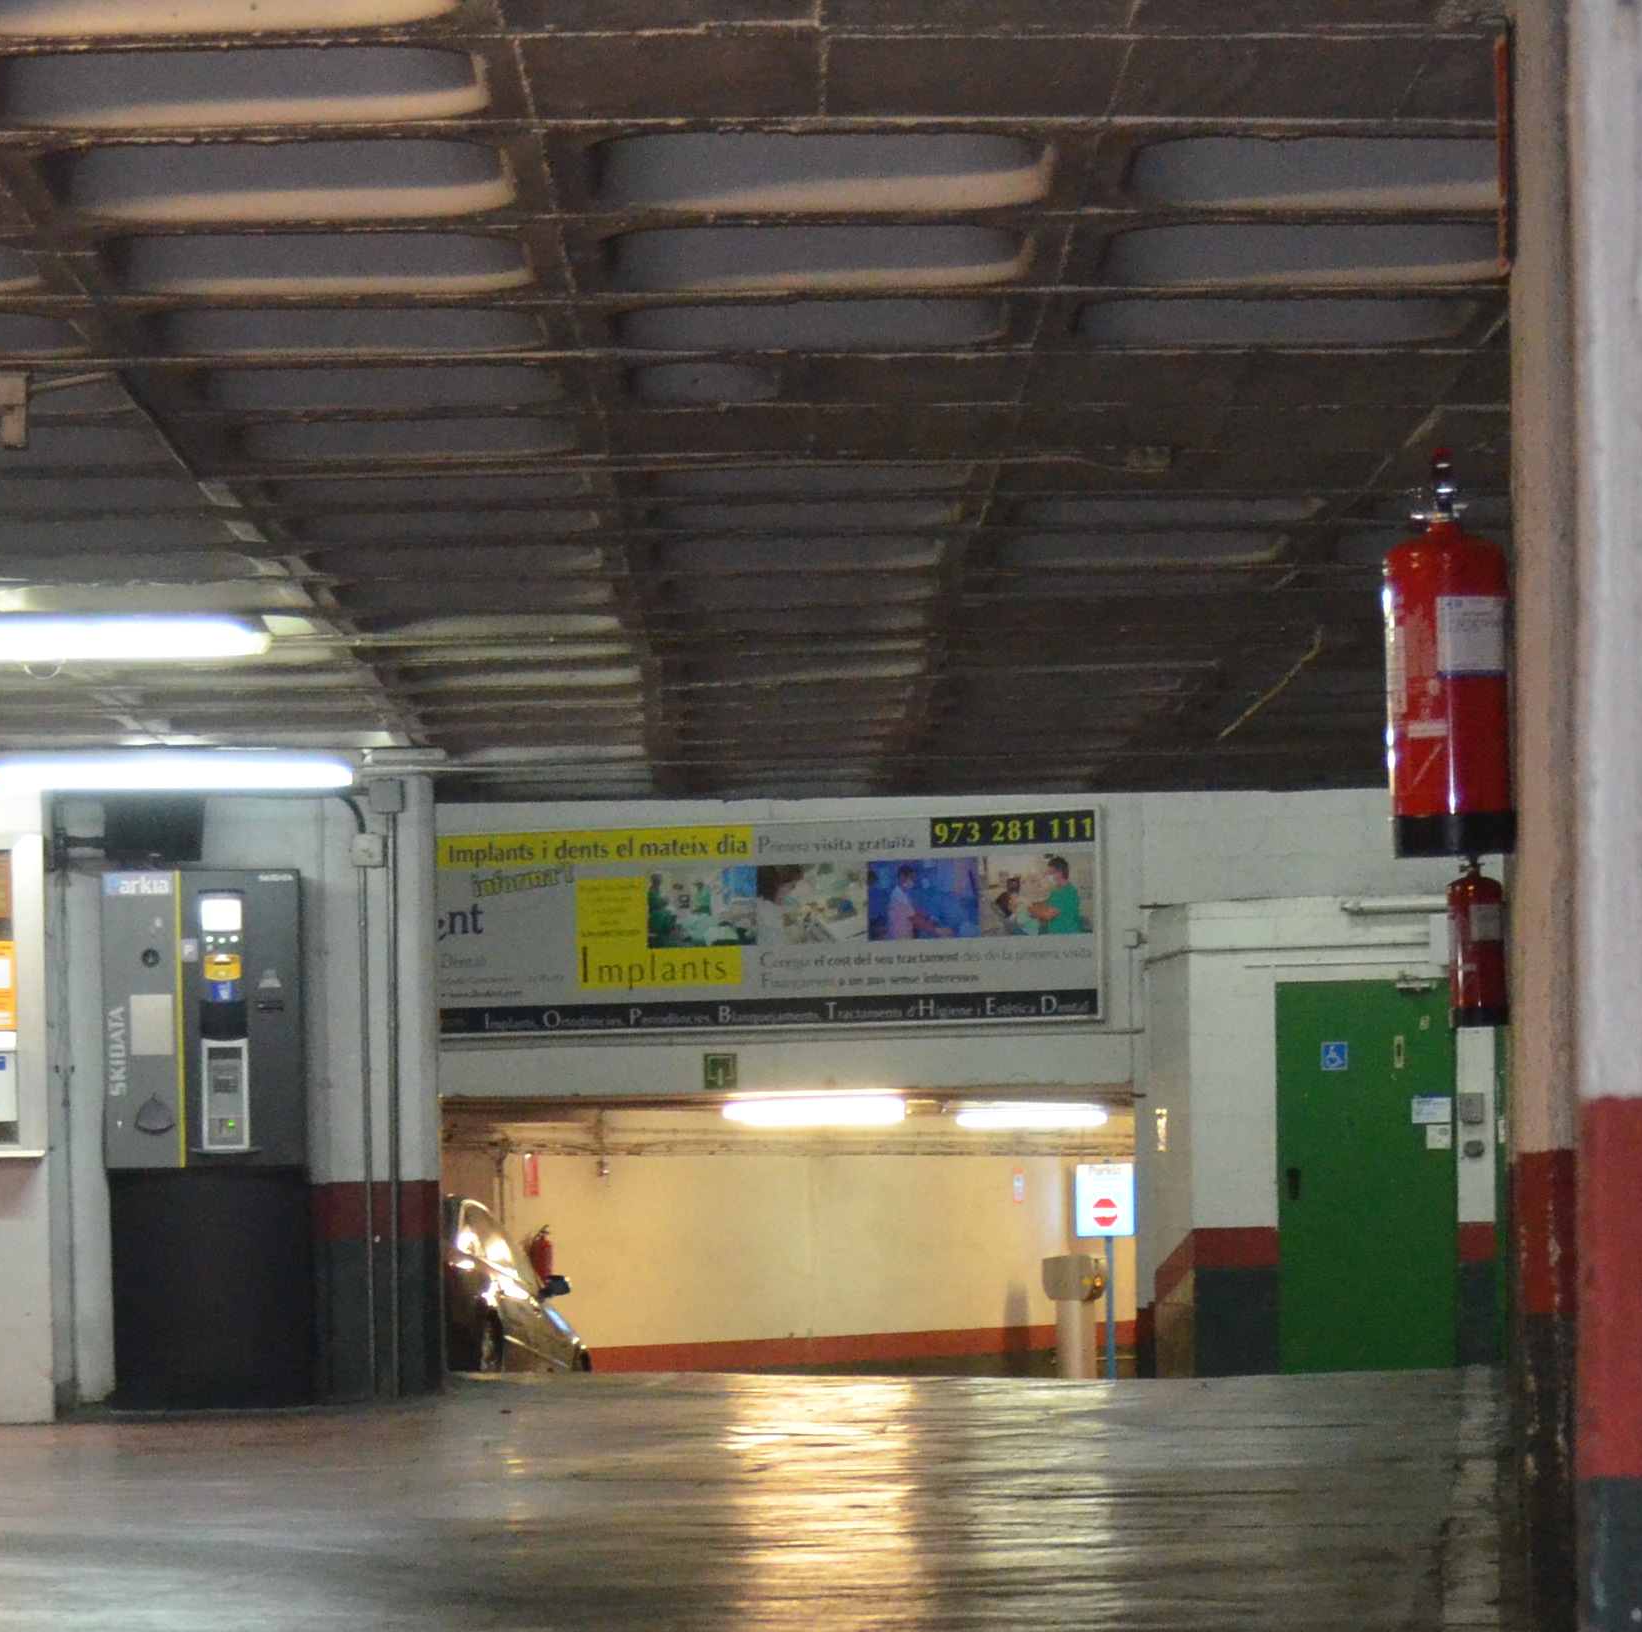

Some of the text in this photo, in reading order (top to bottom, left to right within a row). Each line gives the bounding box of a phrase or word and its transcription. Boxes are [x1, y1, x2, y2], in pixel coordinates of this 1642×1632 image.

[813, 837, 852, 852] visita
[933, 816, 1093, 844] 973 281 111
[448, 842, 534, 868] Implants
[541, 840, 548, 860] i
[554, 839, 609, 860] dents
[615, 837, 634, 858] el
[639, 835, 709, 857] mateix
[581, 946, 728, 990] Implants
[1040, 995, 1090, 1015] Dental
[109, 1005, 127, 1097] SKIDATA
